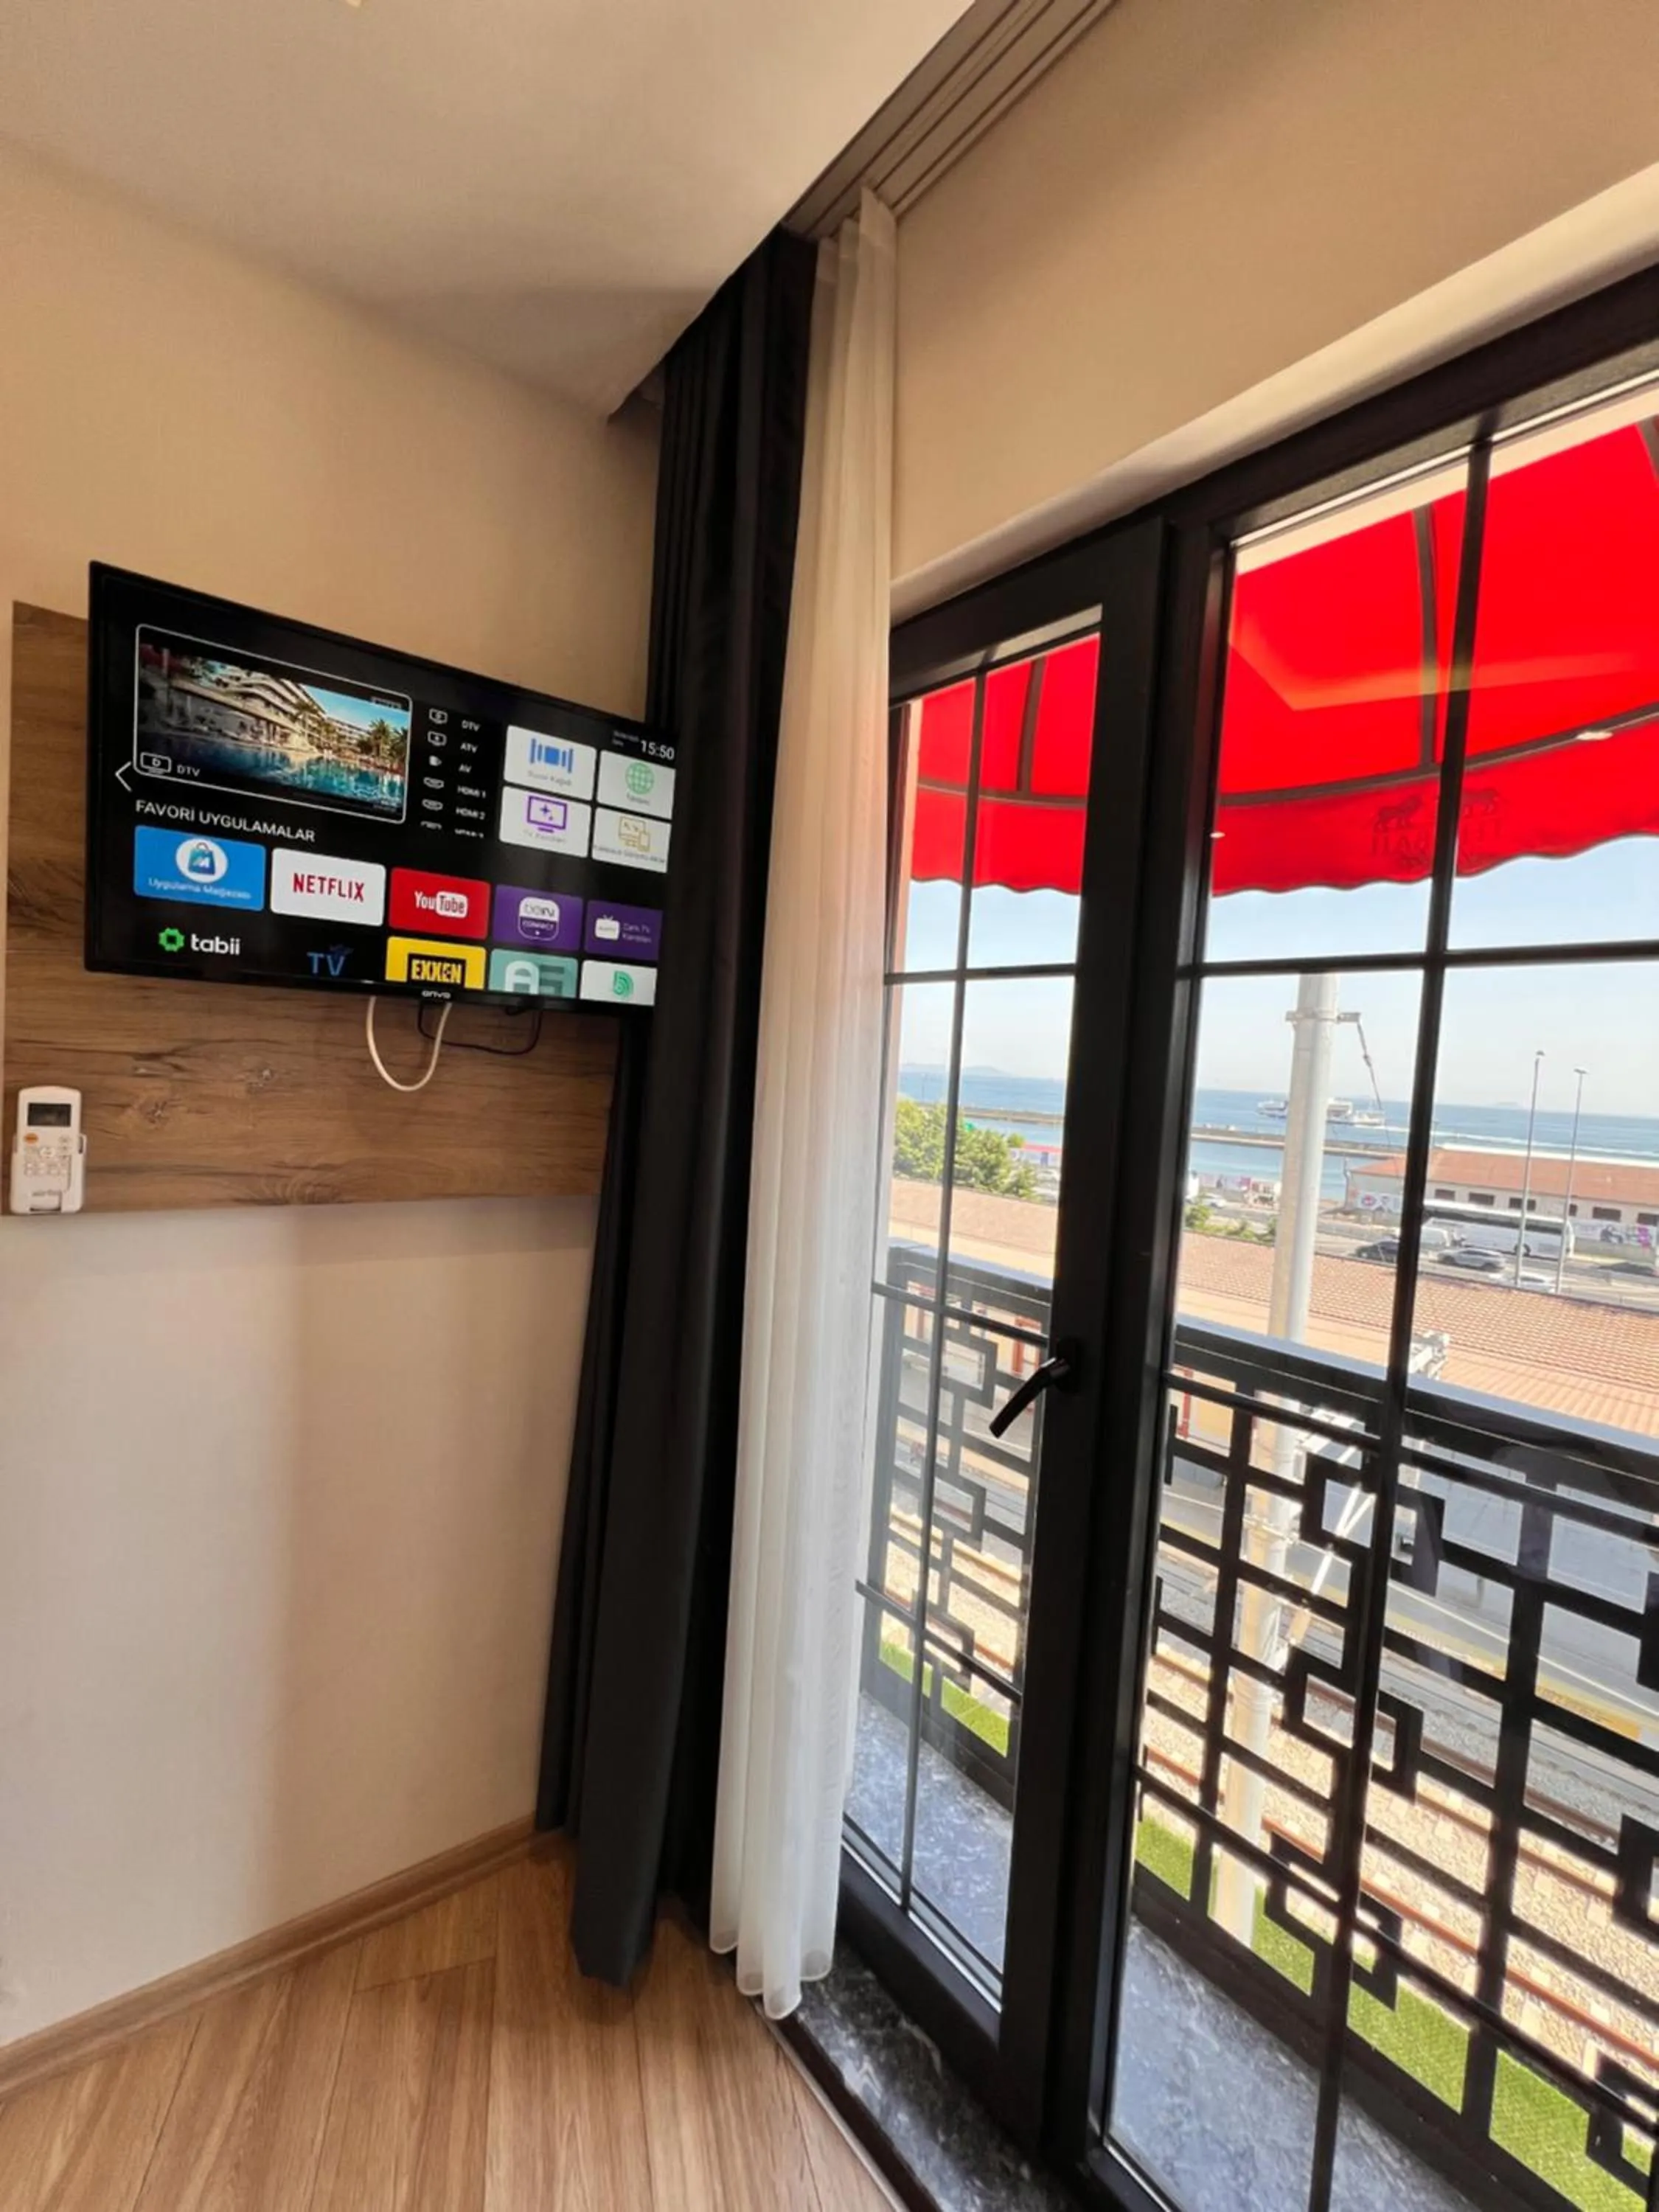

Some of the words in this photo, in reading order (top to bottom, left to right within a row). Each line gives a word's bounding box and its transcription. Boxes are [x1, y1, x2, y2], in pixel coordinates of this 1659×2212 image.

[461, 720, 481, 731] DTV
[460, 742, 479, 754] ATV
[640, 740, 675, 760] 15:50
[176, 764, 201, 777] DTV
[199, 810, 316, 843] UYGULAMALAR
[292, 872, 365, 902] NETFLIX
[414, 890, 467, 918] YouTube
[189, 932, 241, 956] tabii
[306, 951, 347, 978] TV
[411, 959, 462, 984] EXXEN
